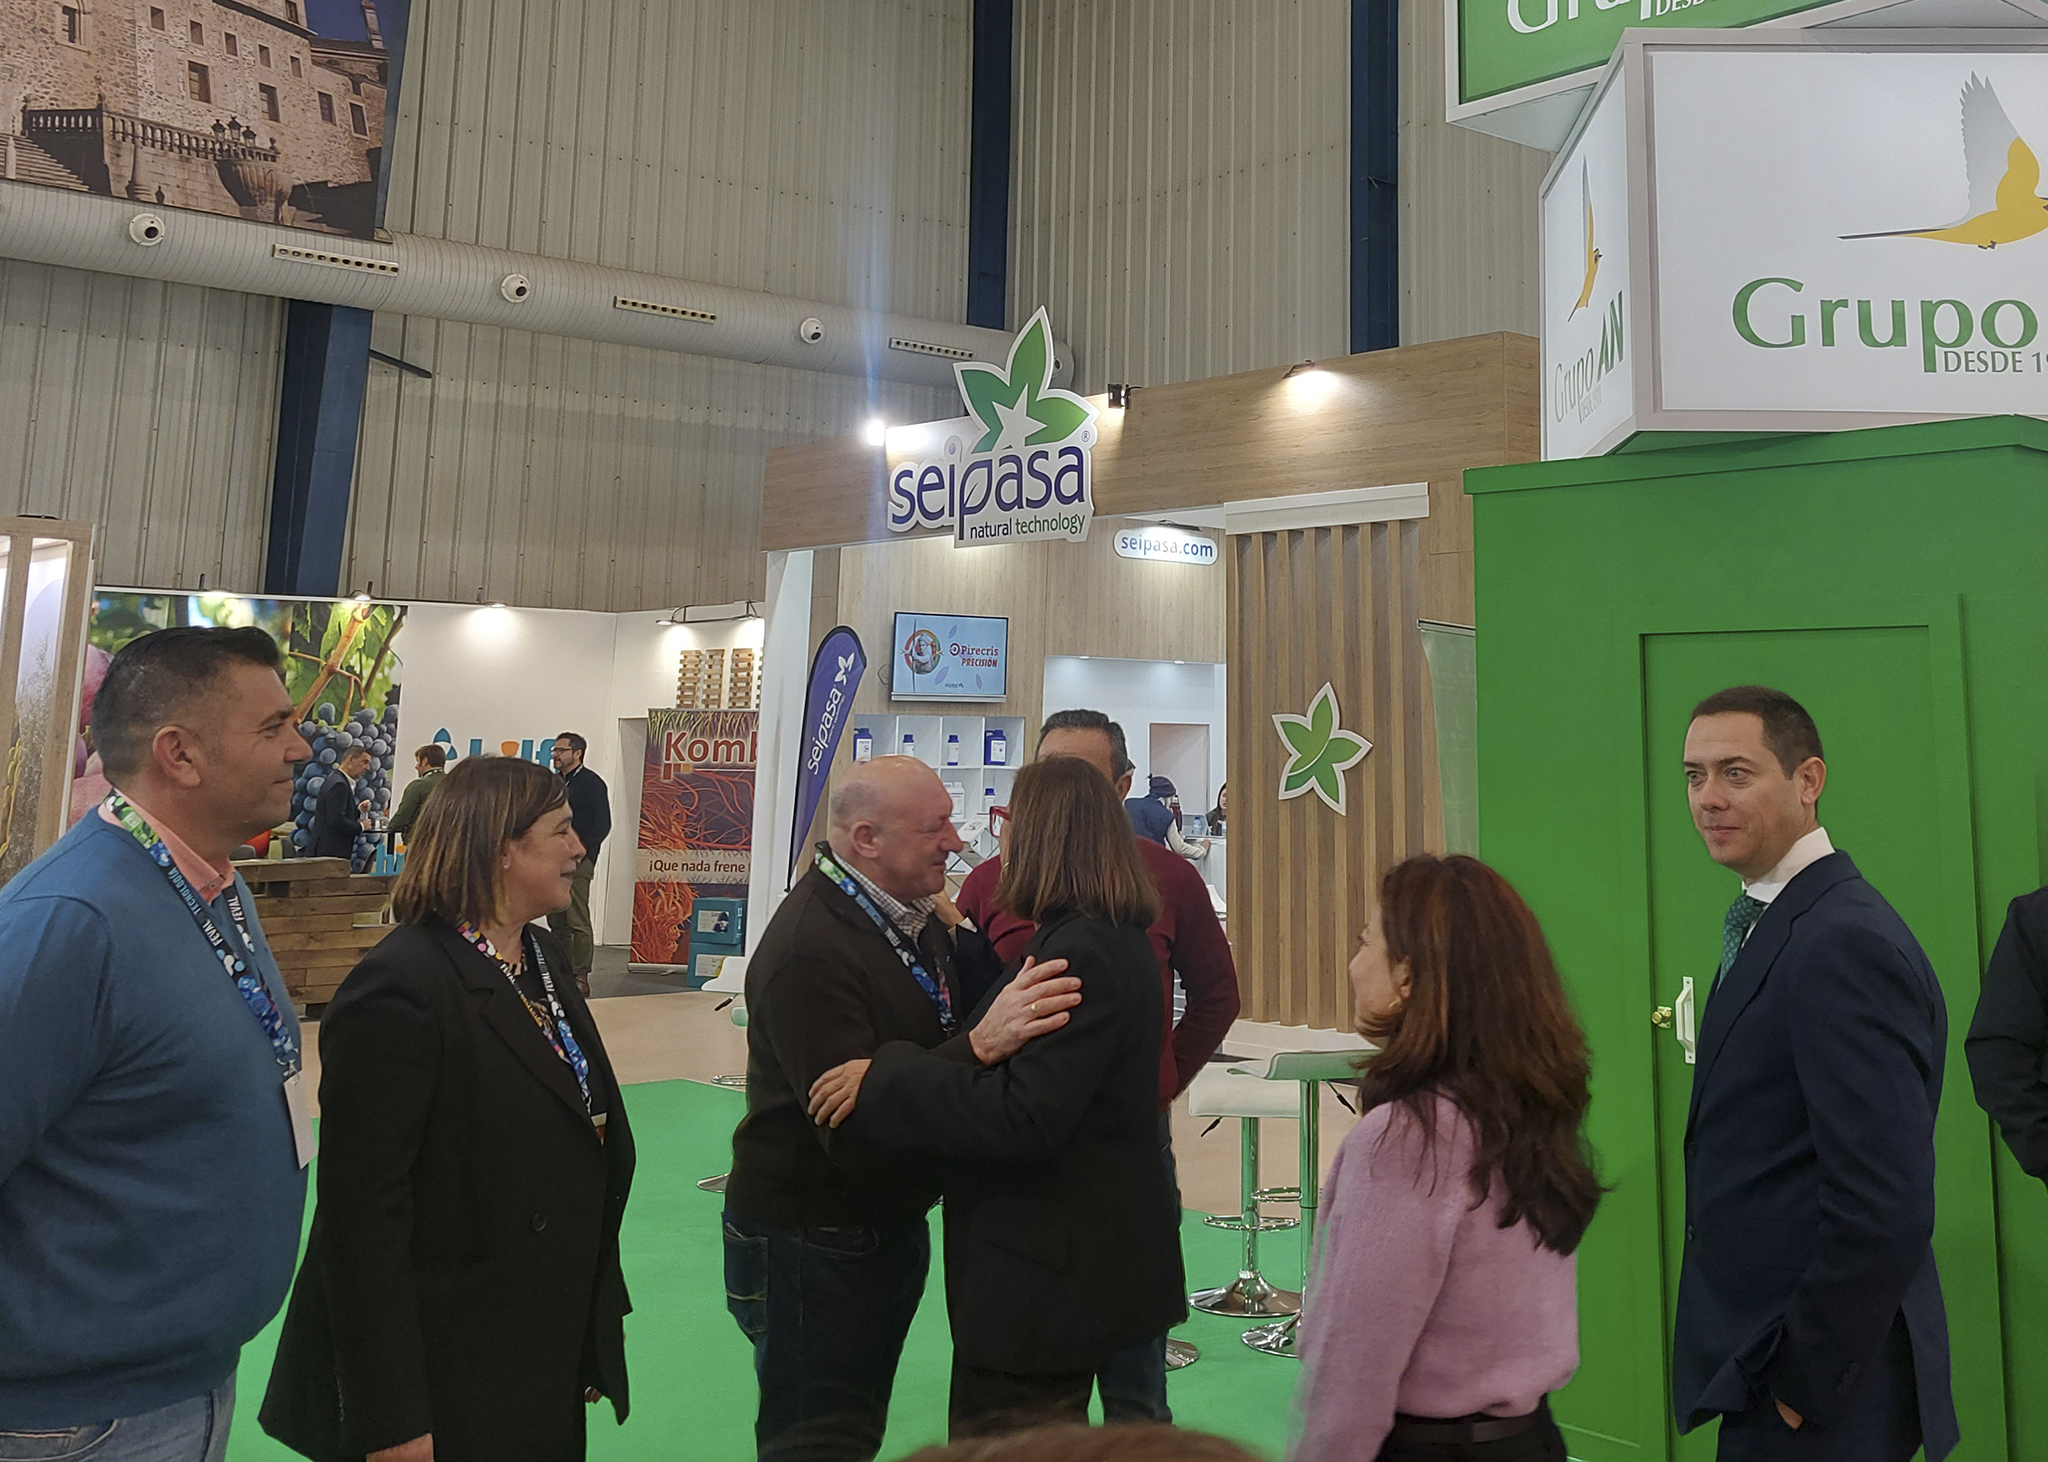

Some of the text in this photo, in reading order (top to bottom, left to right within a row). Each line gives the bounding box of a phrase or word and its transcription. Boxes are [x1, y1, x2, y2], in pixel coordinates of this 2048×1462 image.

[1732, 277, 2039, 373] Grupo
[1555, 347, 1594, 423] Grupo
[1597, 290, 1624, 383] AN
[1943, 350, 2024, 373] DESDE
[892, 442, 1086, 541] seipasa
[970, 512, 1086, 539] natural technology
[1121, 534, 1213, 557] seipasa.com
[807, 687, 843, 775] seipasa
[649, 859, 746, 873] ¡Que nada frene
[227, 896, 245, 922] FEVAL
[202, 919, 224, 947] FEVAL
